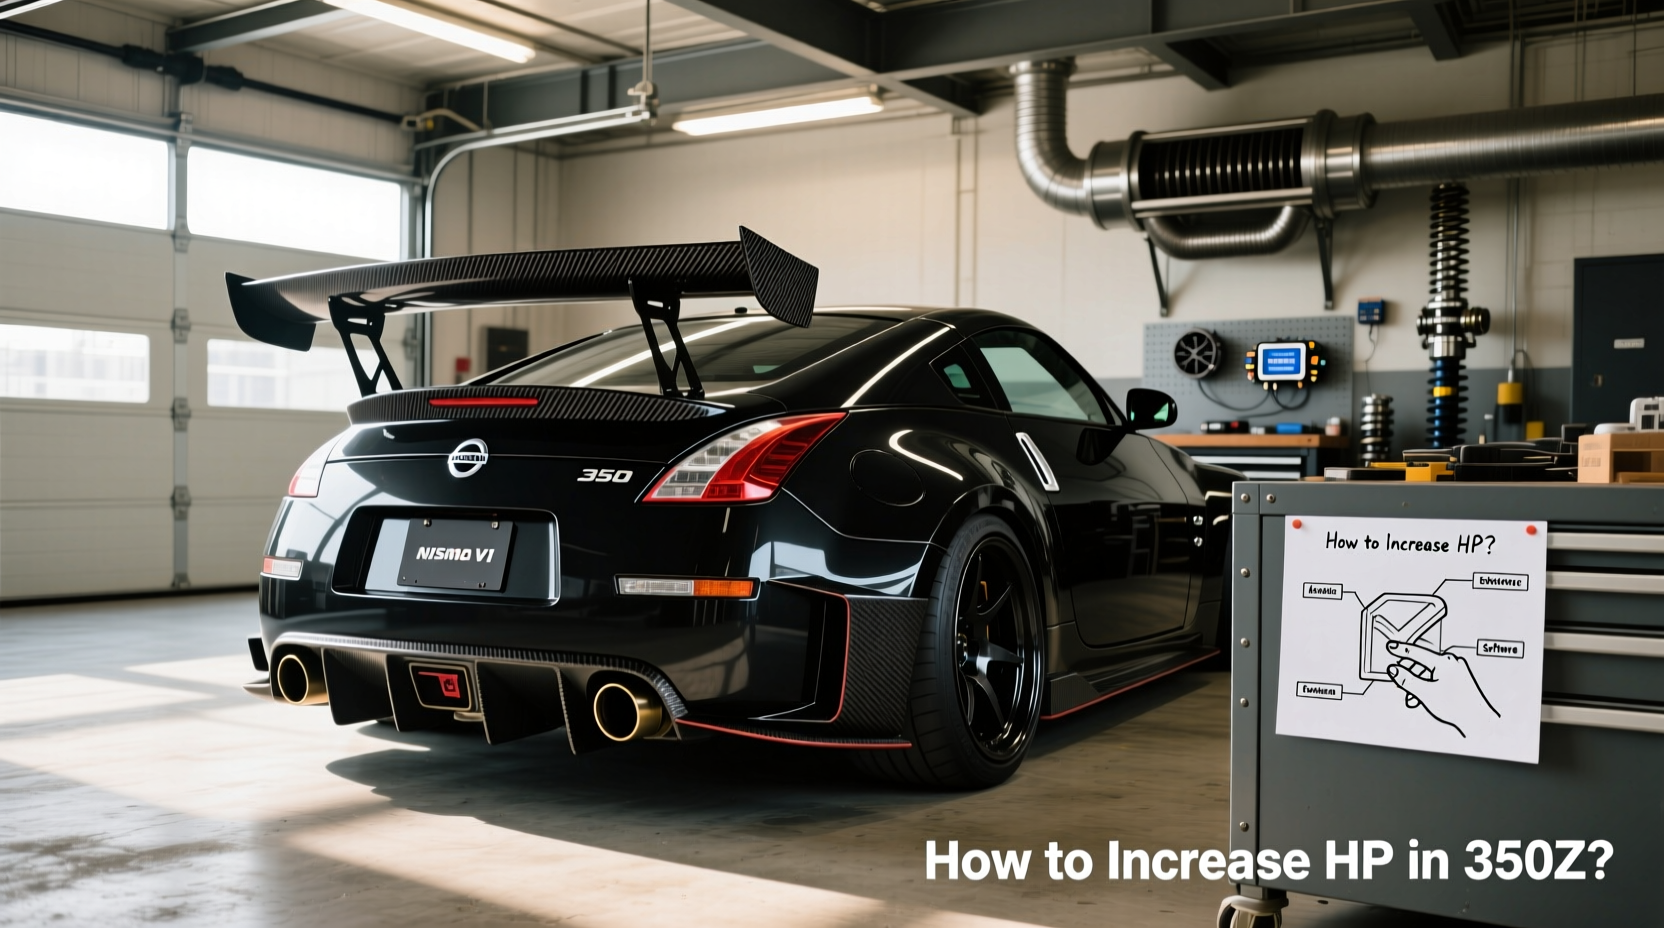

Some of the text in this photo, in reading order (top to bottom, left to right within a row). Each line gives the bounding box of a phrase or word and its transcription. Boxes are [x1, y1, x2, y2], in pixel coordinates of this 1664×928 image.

[577, 469, 634, 483] 350
[1325, 531, 1496, 555] How to Increase HP?
[416, 546, 495, 563] NISMO VI
